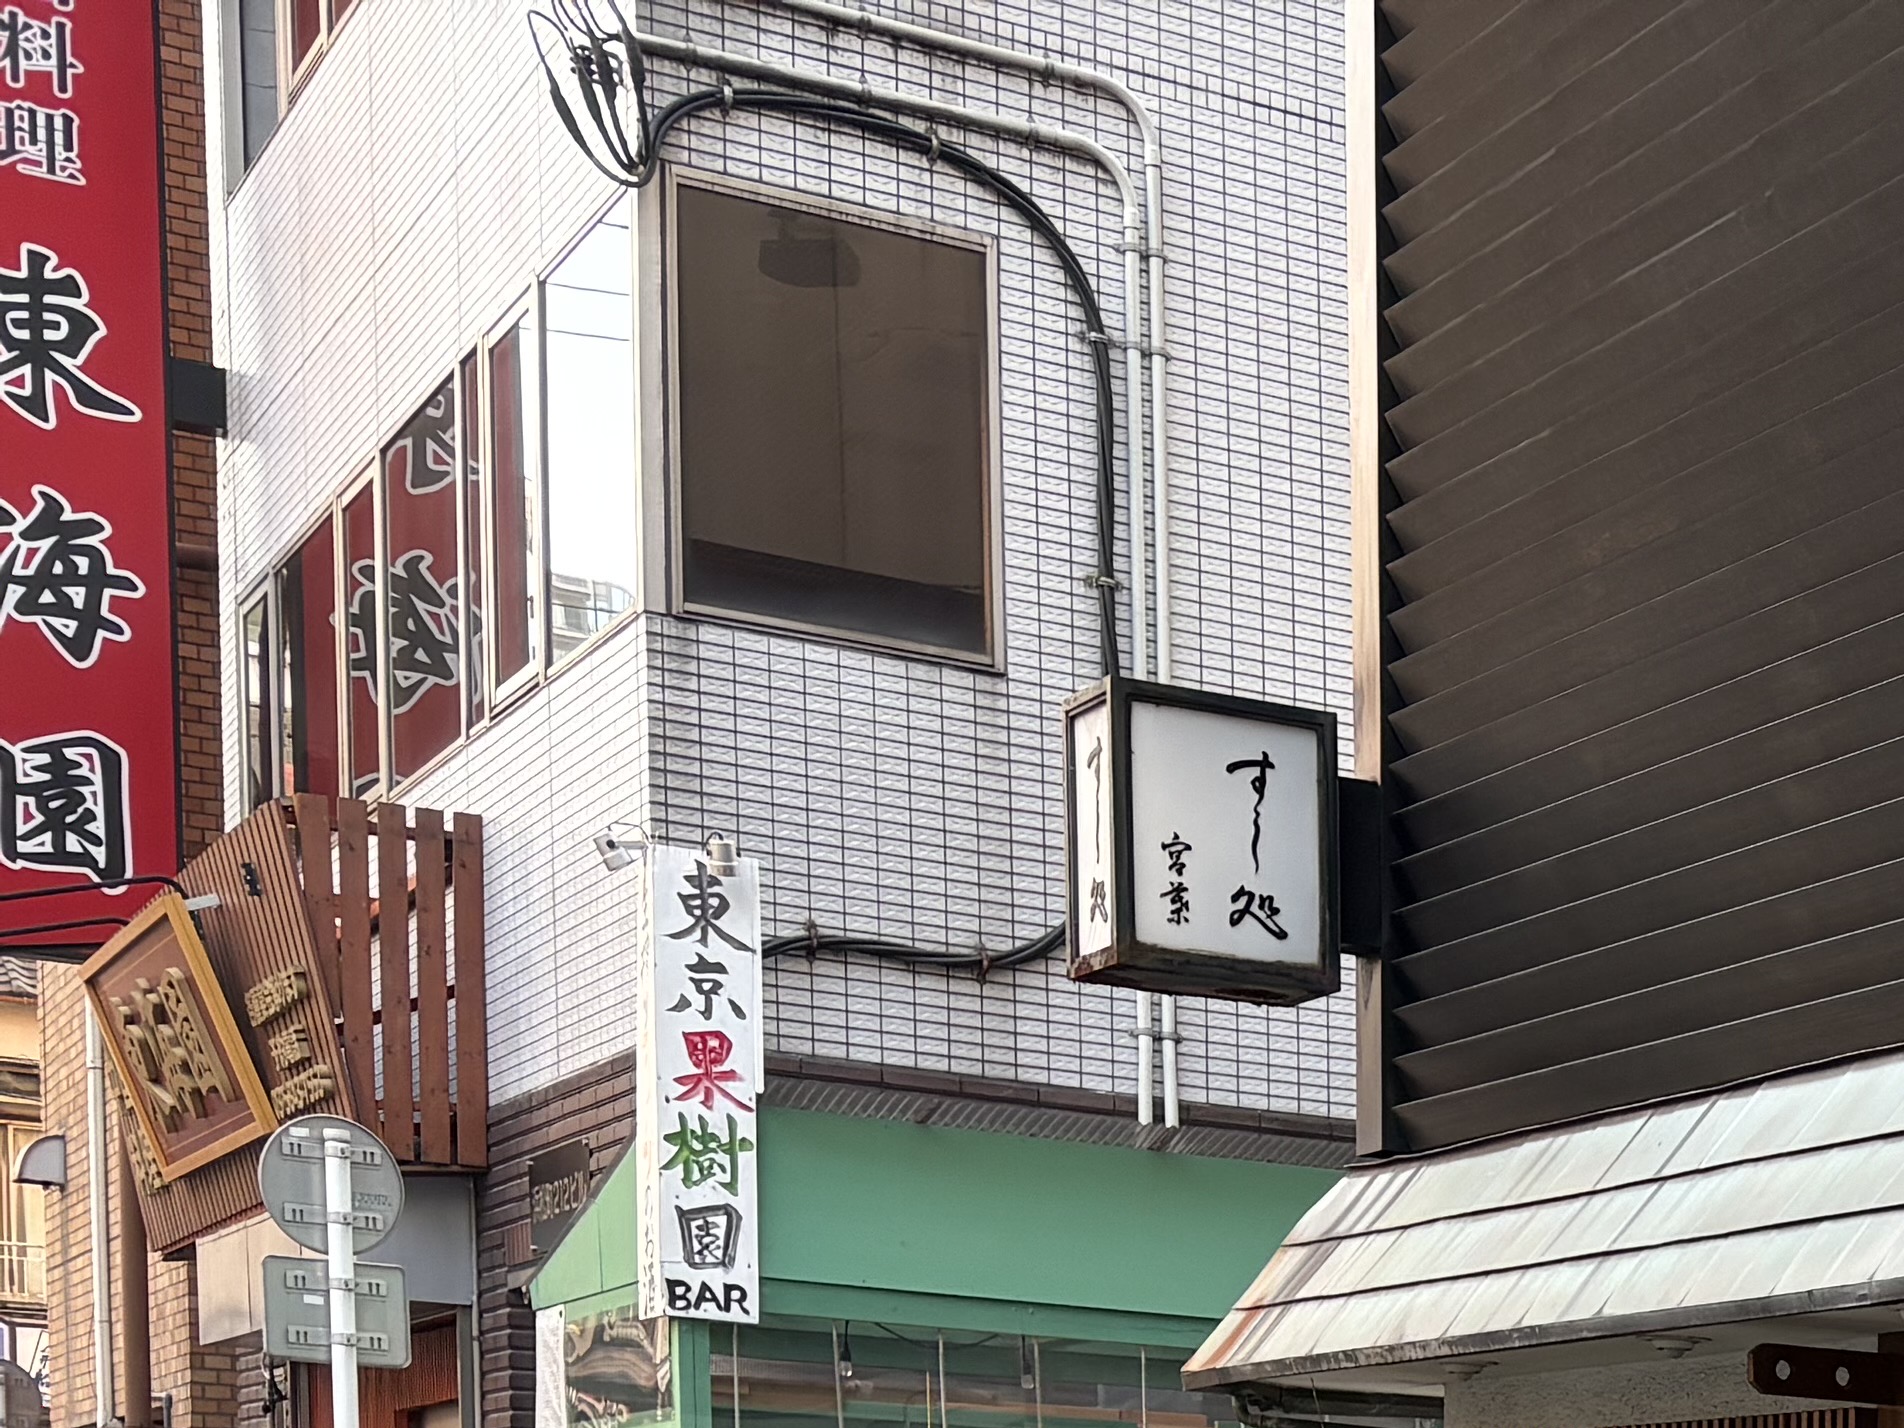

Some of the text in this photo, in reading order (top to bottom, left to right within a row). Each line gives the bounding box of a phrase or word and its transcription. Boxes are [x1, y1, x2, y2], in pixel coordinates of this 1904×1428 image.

[0, 0, 84, 186] 料理
[0, 243, 146, 895] 東海園
[1226, 751, 1288, 940] すし処
[660, 859, 757, 1270] 東京果樹園
[666, 1278, 750, 1317] BAR
